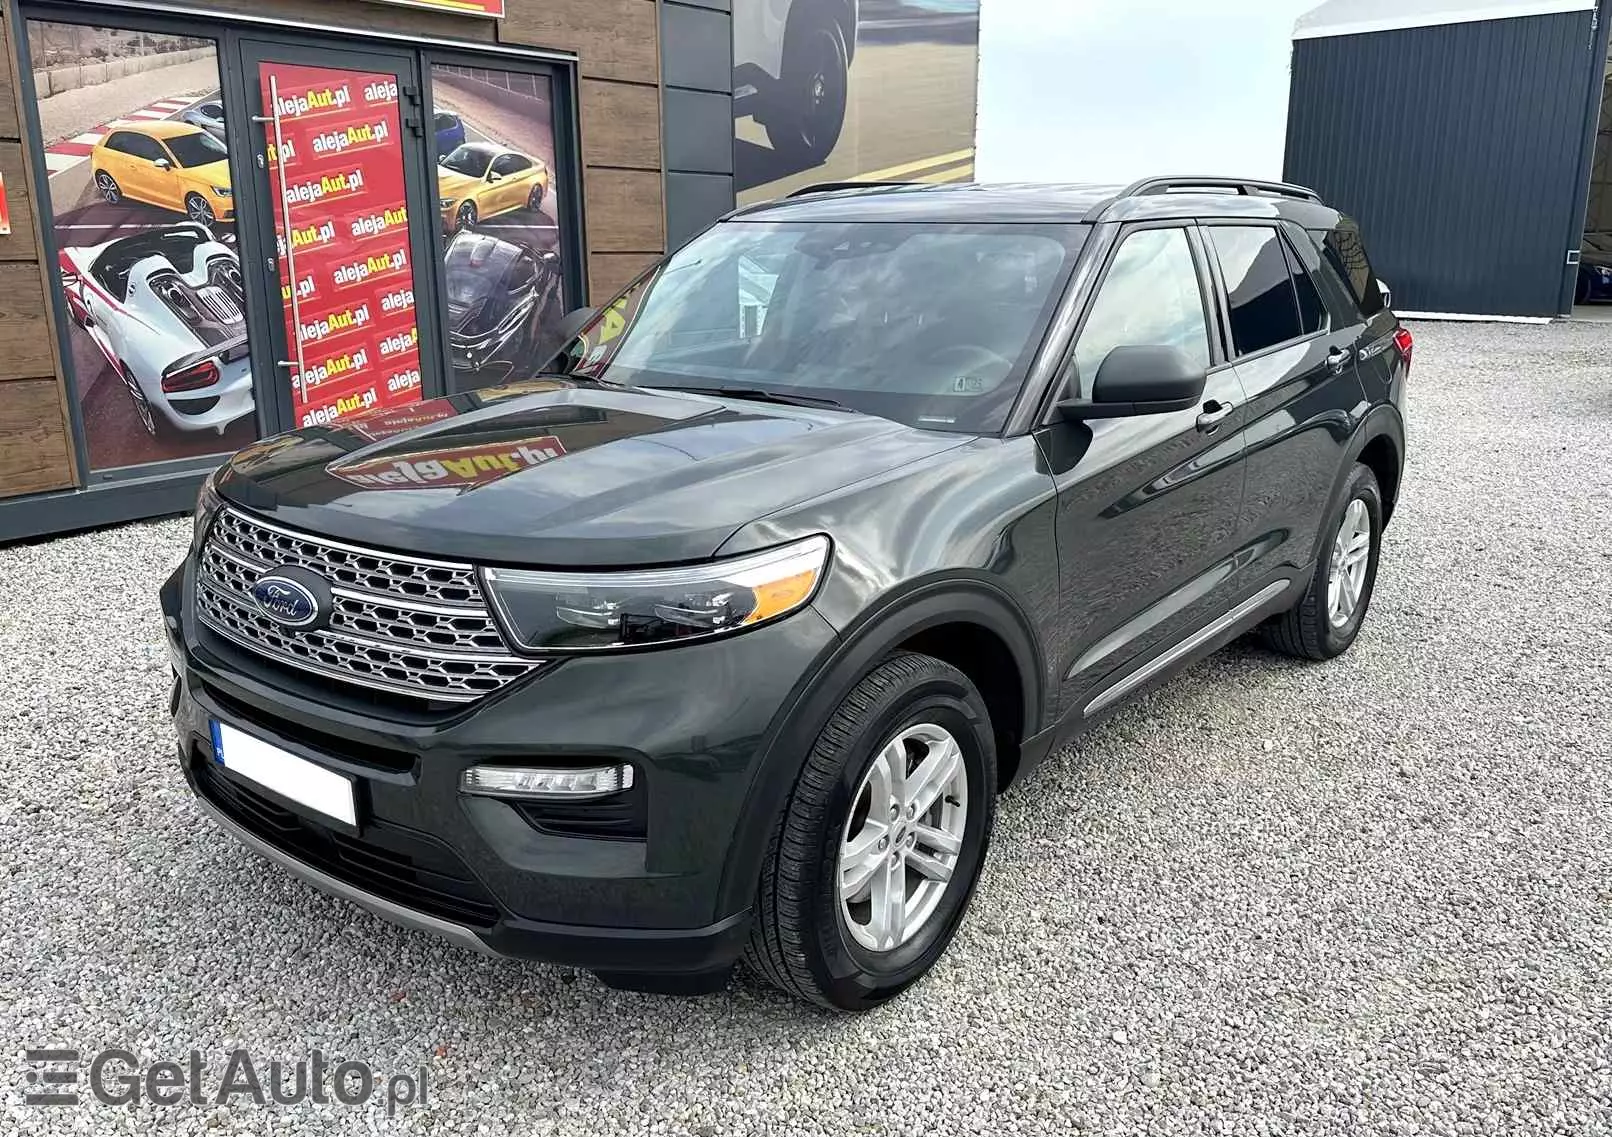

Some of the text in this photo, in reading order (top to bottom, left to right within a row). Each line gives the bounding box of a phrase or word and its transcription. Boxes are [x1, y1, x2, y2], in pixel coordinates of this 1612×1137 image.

[312, 120, 388, 152] alejaAut.pl
[286, 169, 364, 203] alejaAut.pl
[333, 249, 406, 284] alejaAut.pl
[381, 289, 414, 311] aleja
[297, 304, 370, 341] lejaAut.pl
[291, 349, 368, 388] aejaAut.pl
[387, 370, 421, 392] aleja
[302, 388, 377, 428] alejaAut.pl
[264, 585, 299, 616] Ford
